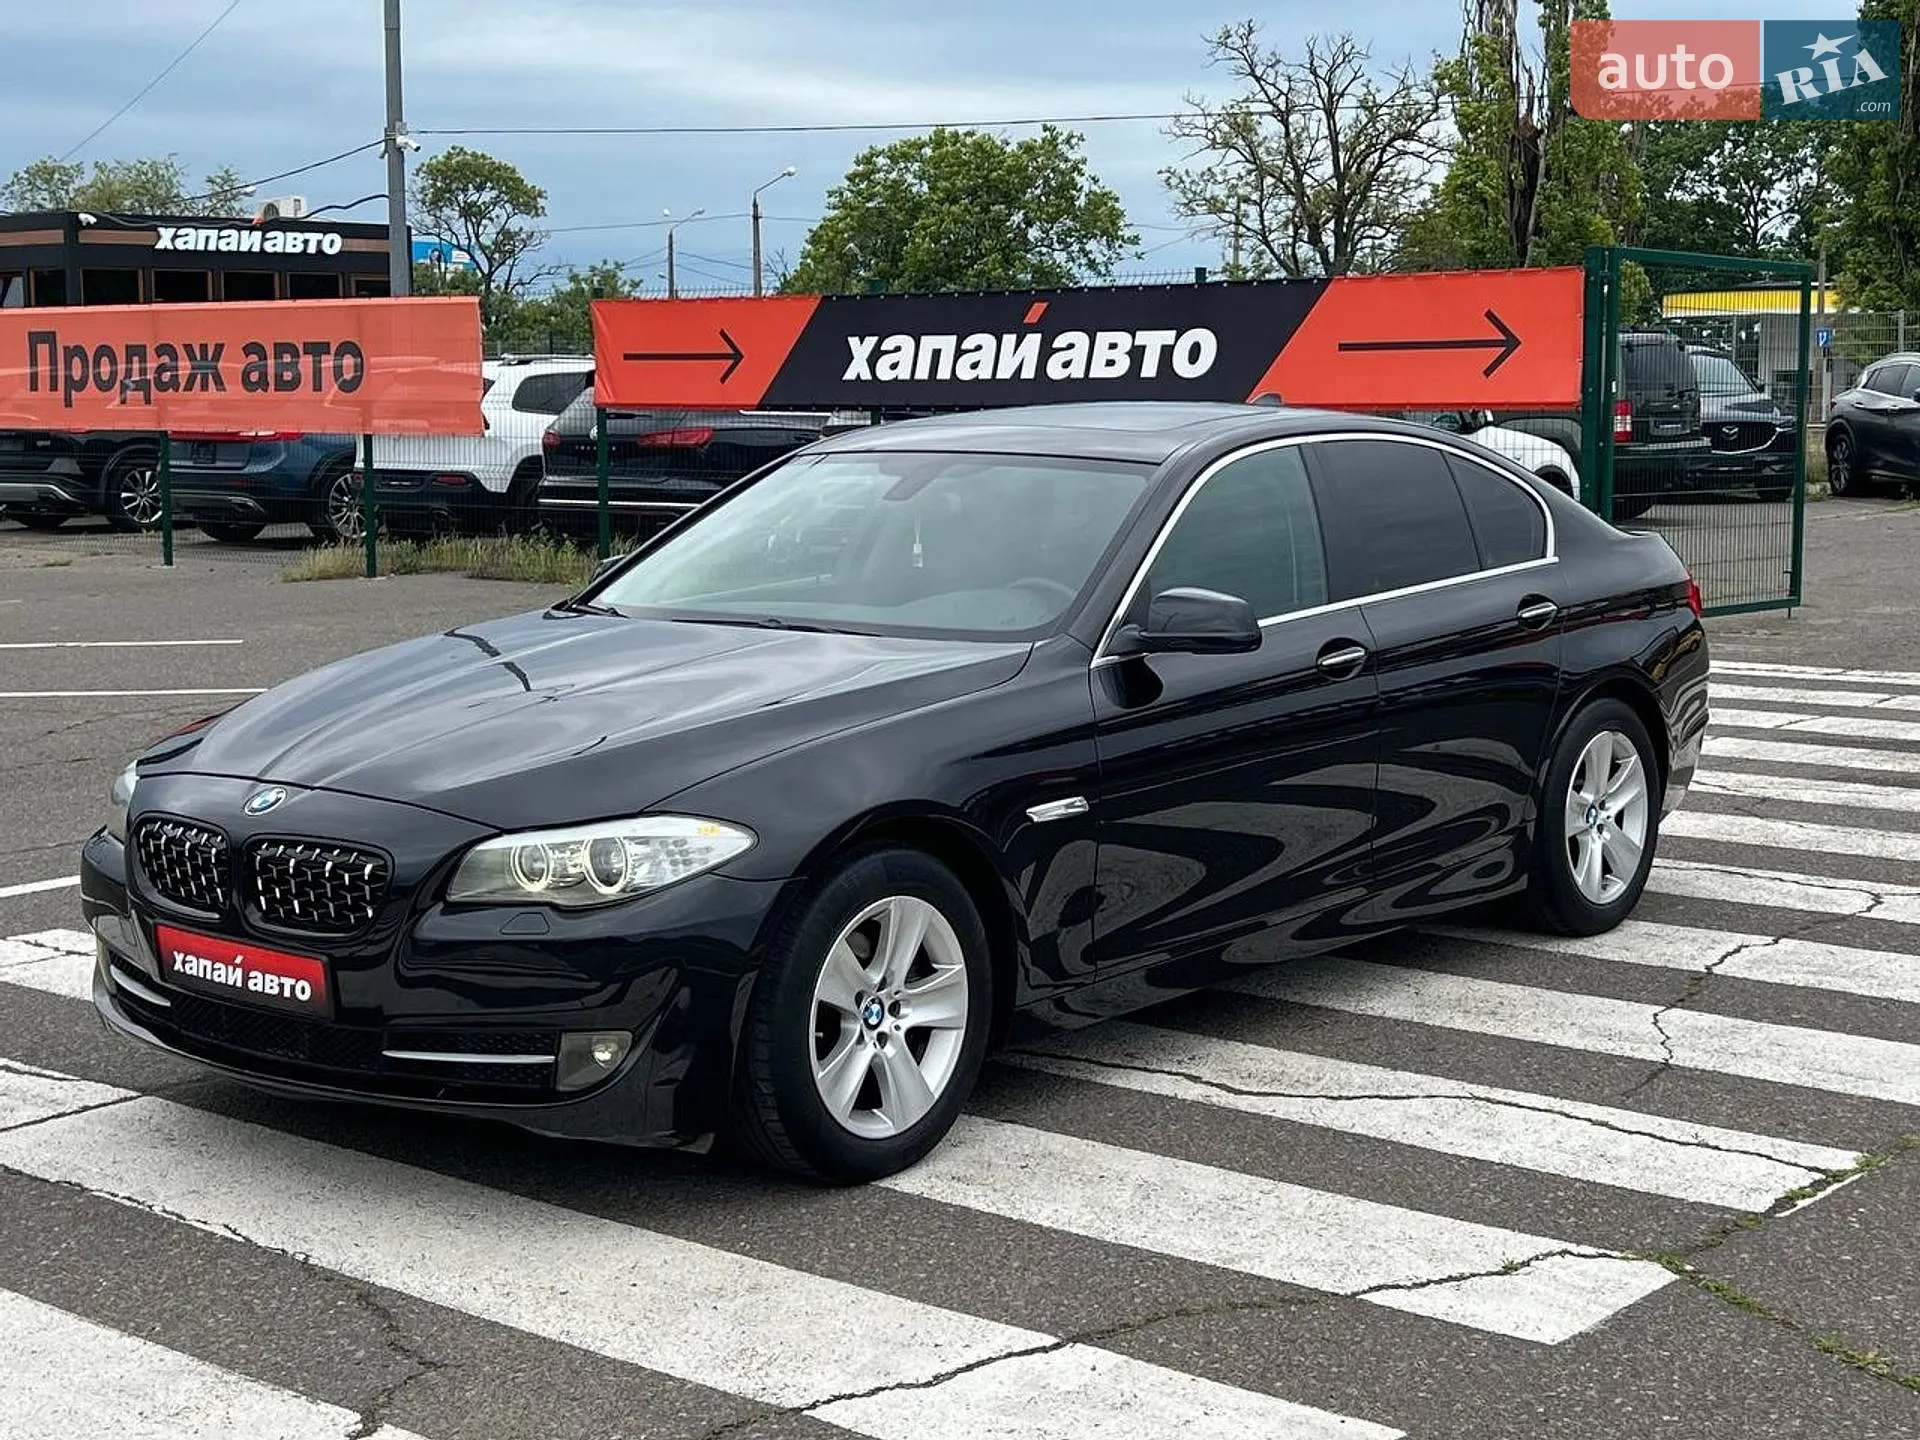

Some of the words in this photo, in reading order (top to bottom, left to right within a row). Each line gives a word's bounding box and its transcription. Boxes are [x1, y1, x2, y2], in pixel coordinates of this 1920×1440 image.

[27, 330, 227, 408] Продаж
[240, 340, 365, 395] авто
[1045, 327, 1219, 380] авто
[172, 951, 244, 988] хапай
[247, 970, 312, 1001] авто
